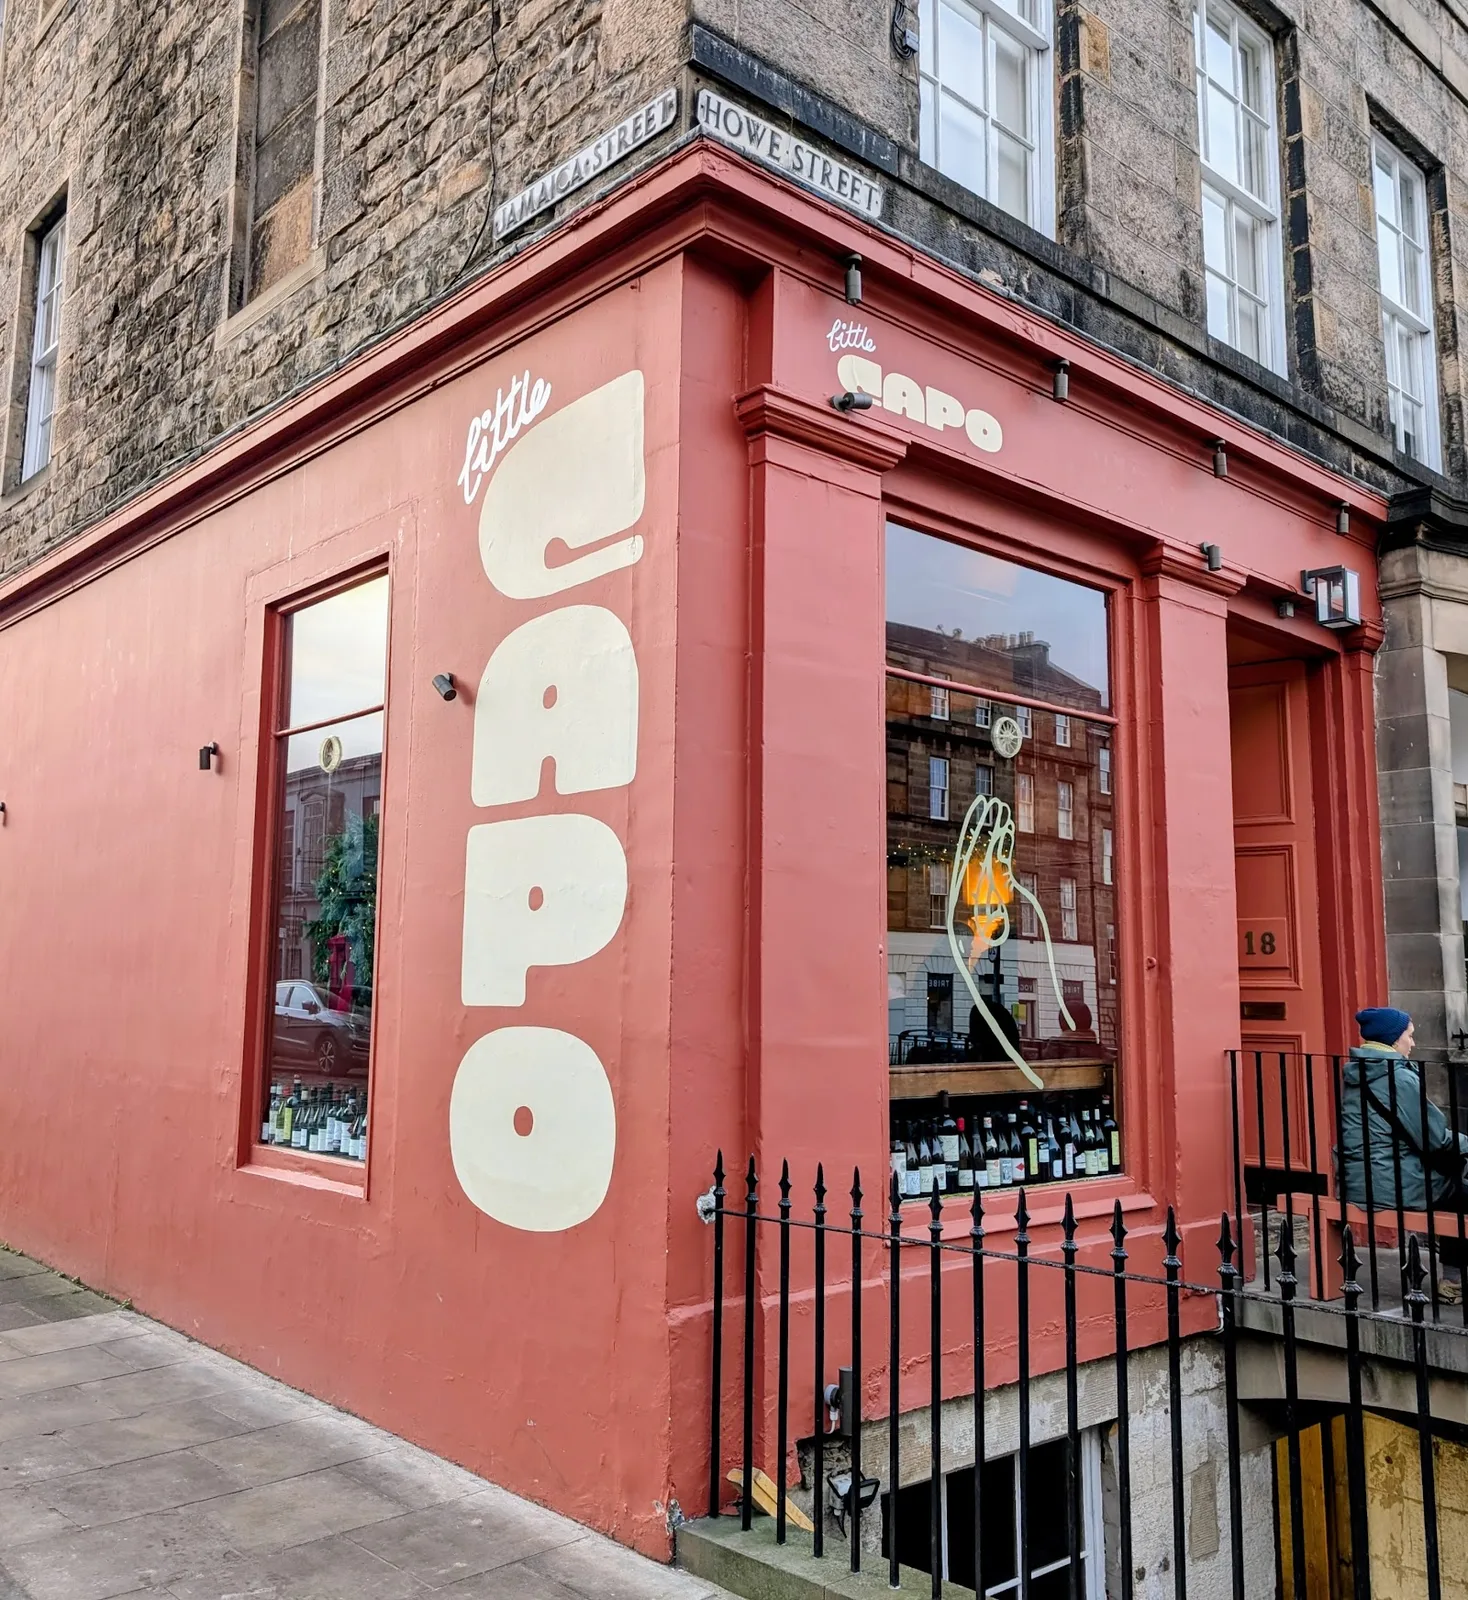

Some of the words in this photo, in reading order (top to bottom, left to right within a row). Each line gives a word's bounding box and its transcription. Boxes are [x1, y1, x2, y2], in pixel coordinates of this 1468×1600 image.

[496, 157, 584, 234] JAMAICA
[592, 91, 672, 173] STREET
[704, 94, 783, 163] HOWE
[791, 144, 880, 212] STREET
[826, 318, 876, 352] little
[457, 369, 552, 505] little
[837, 354, 1003, 453] CAPO
[449, 369, 646, 1233] CAPO
[1244, 931, 1276, 955] 18
